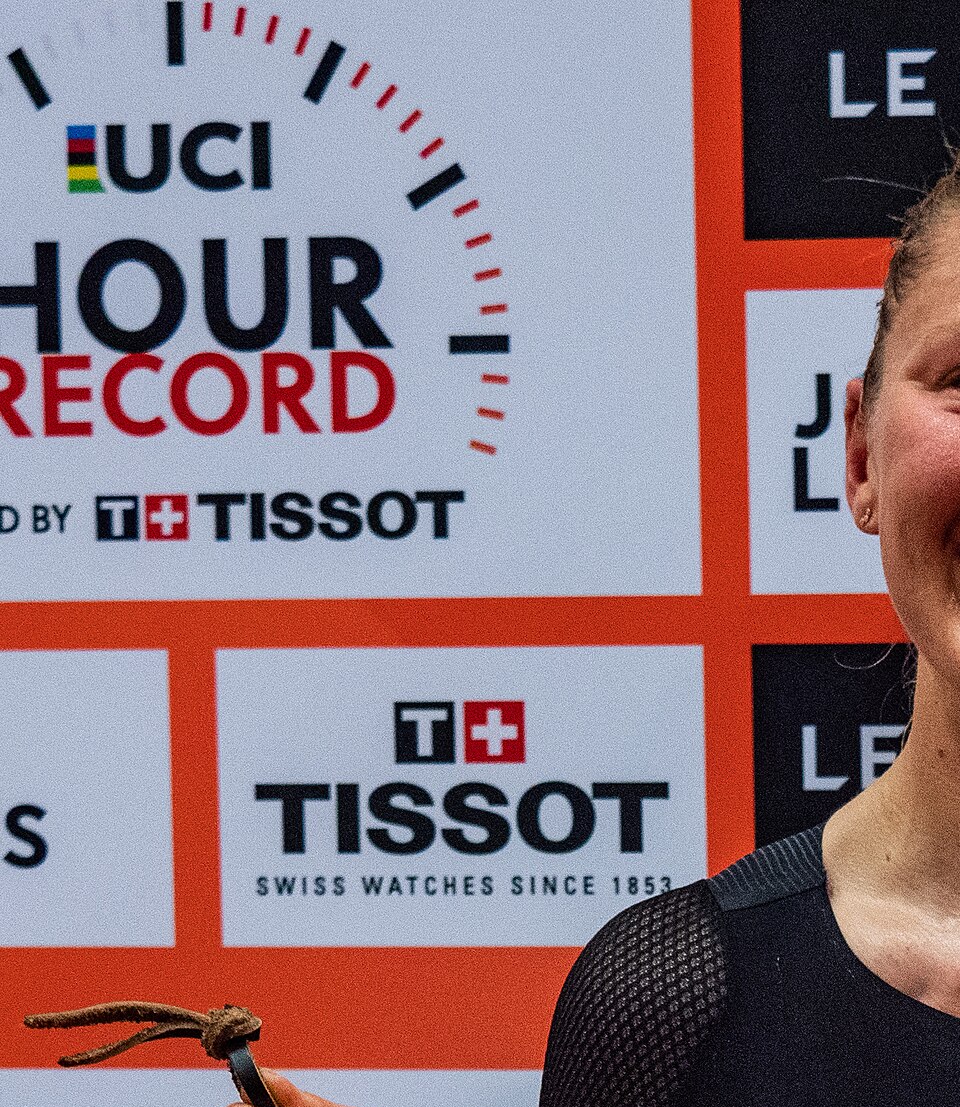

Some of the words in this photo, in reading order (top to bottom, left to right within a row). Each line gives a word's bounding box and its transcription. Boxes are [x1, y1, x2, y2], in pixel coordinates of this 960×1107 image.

[828, 49, 937, 118] LE
[104, 121, 272, 193] UCI
[33, 504, 71, 533] BY
[196, 490, 466, 541] TISSOT
[801, 724, 907, 791] LE
[254, 780, 671, 855] TISSOT
[256, 876, 346, 897] SWISS
[362, 875, 494, 897] WATCHES
[510, 875, 596, 896] SINCE
[612, 875, 672, 897] 1853
